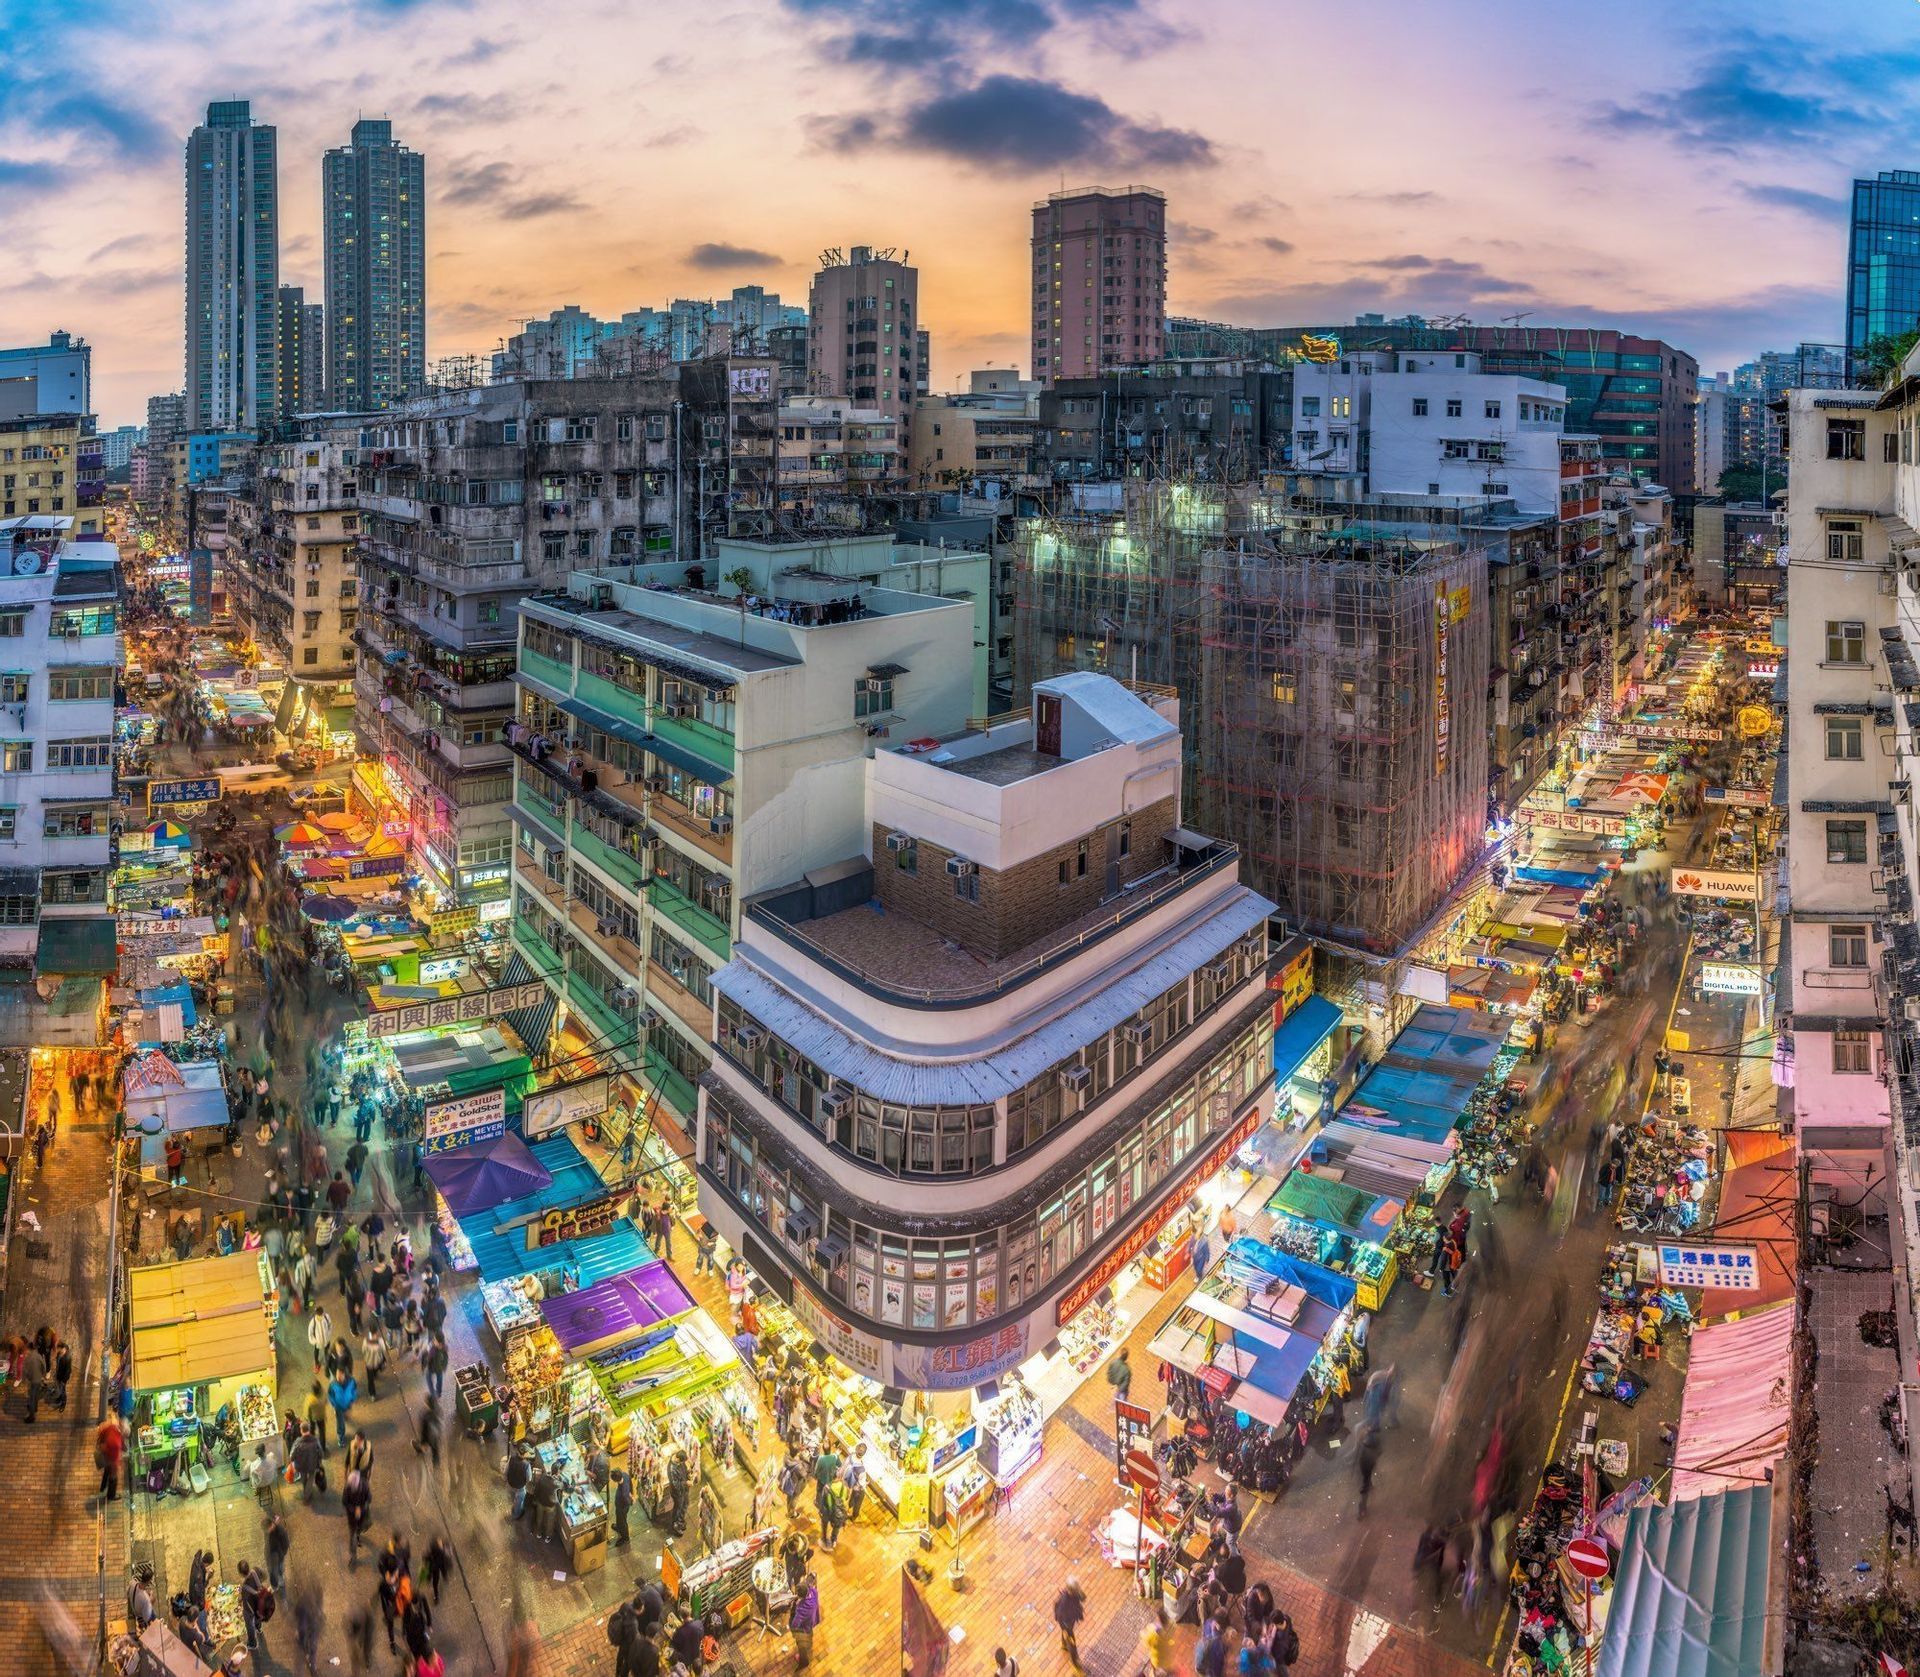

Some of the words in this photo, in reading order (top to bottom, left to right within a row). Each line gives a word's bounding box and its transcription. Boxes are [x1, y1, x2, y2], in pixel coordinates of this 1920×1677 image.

[1707, 881, 1755, 893] HUAWE
[371, 983, 543, 1035] 和興無線電行
[469, 1093, 502, 1107] aiwa
[458, 1103, 501, 1118] GoldStar
[474, 1123, 503, 1135] MEYER
[1682, 1251, 1752, 1268] 港華電訊
[932, 1324, 1023, 1374] 紅蘋果
